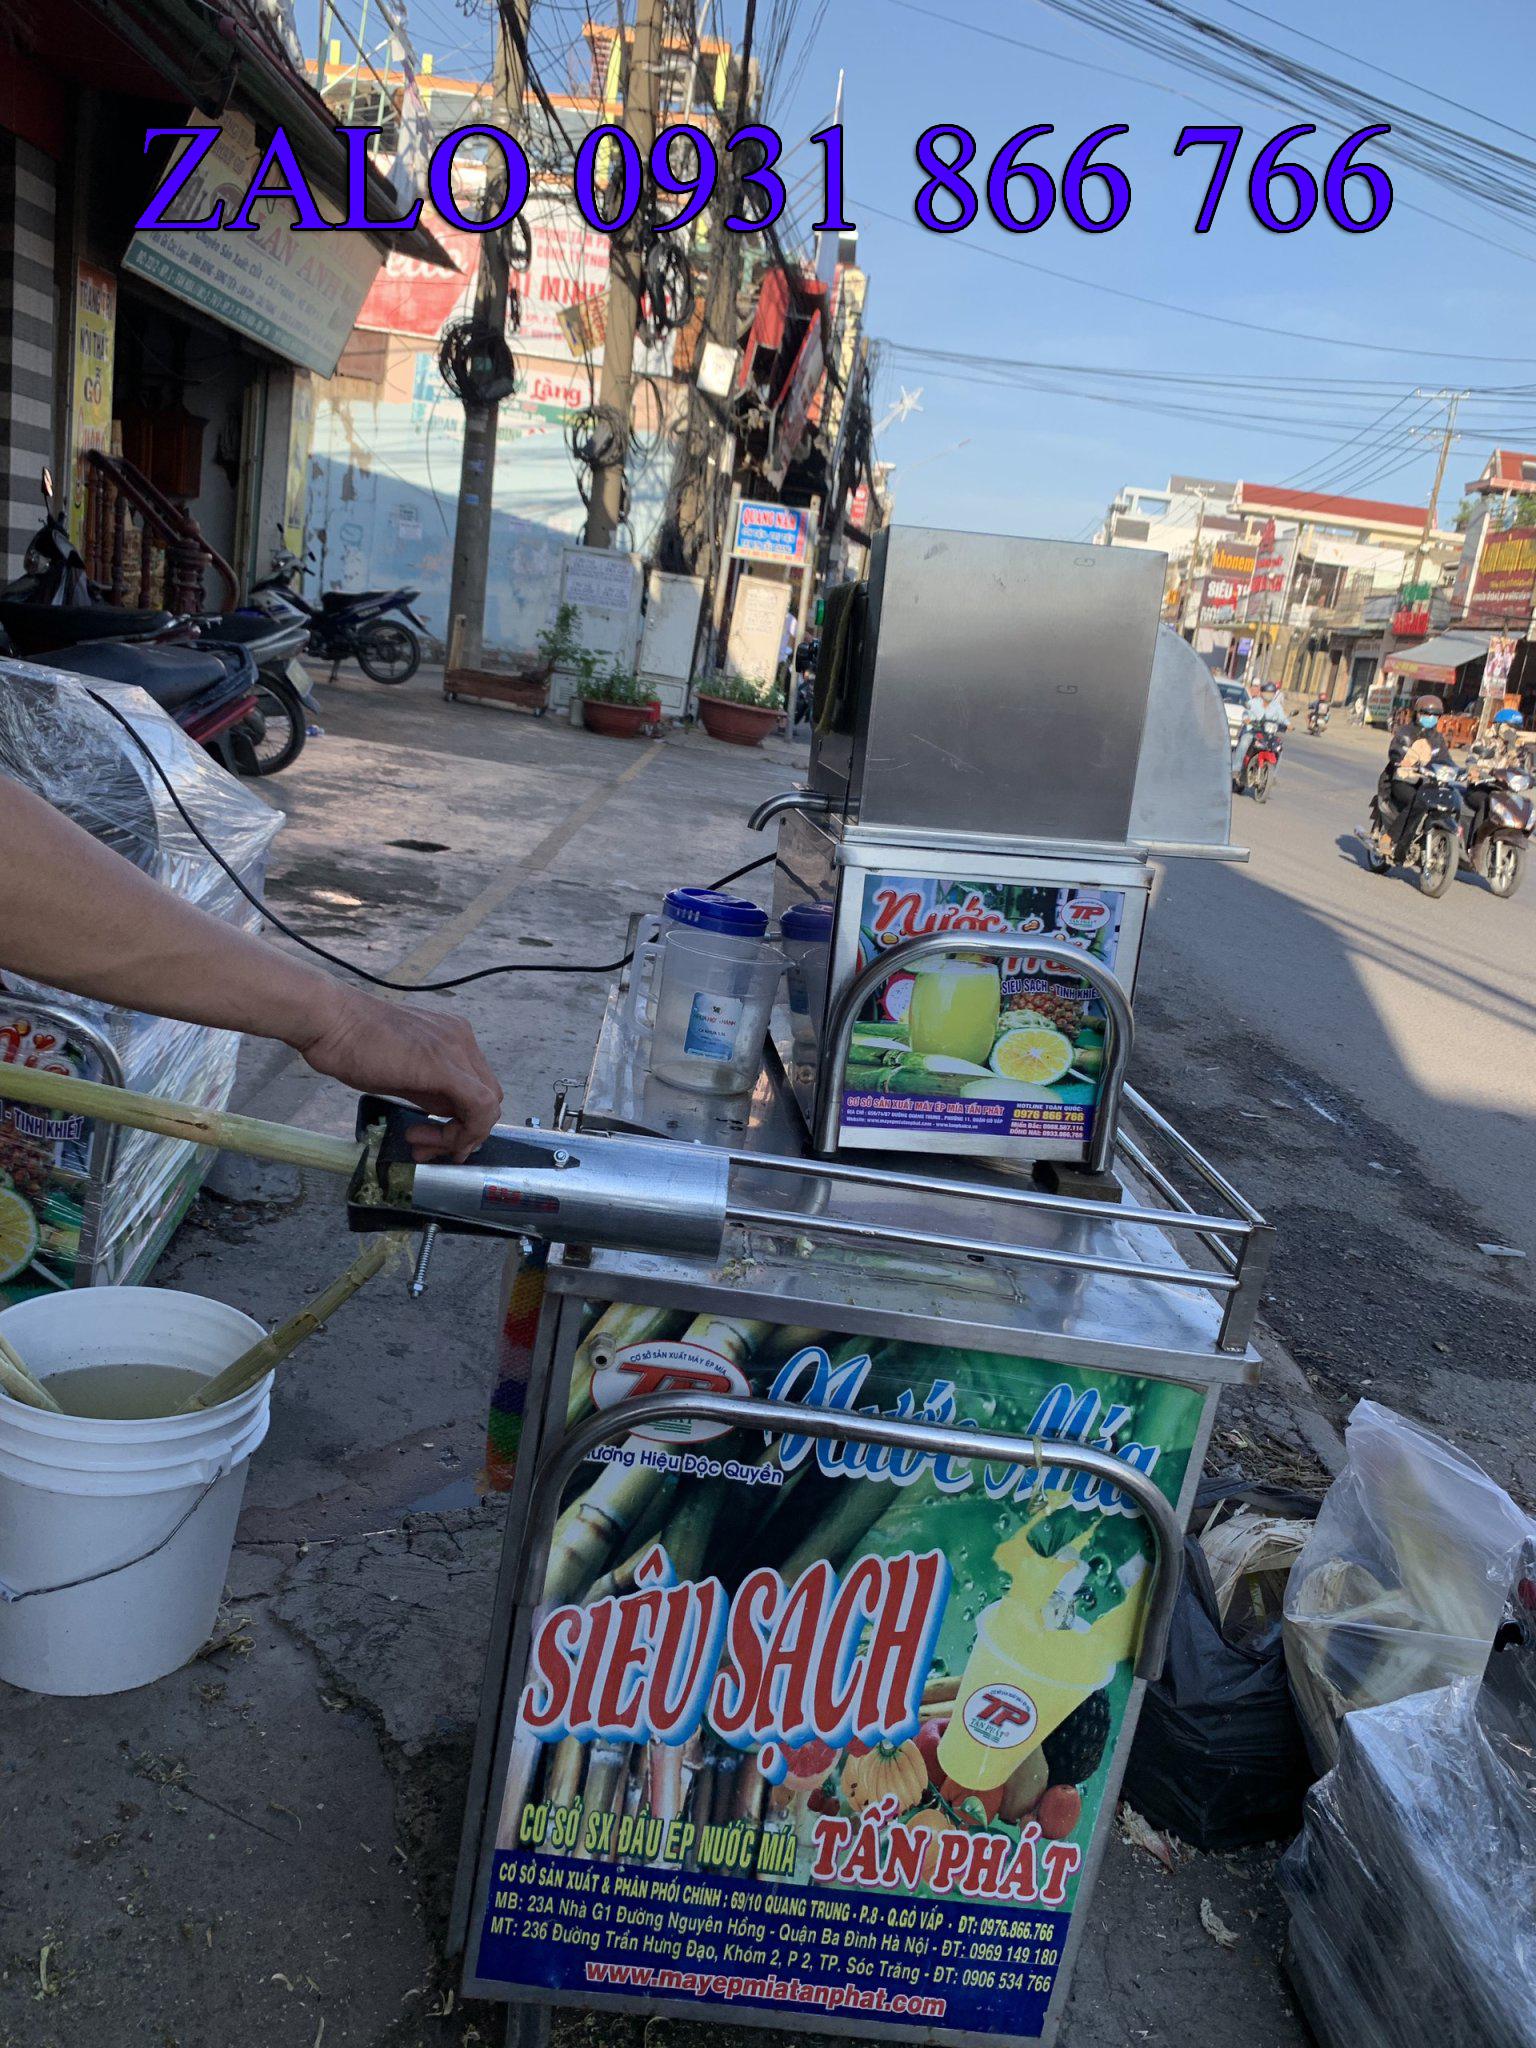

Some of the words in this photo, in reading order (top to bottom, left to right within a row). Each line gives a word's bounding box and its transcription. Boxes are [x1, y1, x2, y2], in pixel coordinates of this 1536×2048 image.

[84, 367, 103, 406] GỖ
[1207, 580, 1234, 600] SIÊU
[1069, 905, 1105, 920] TP
[1001, 979, 1023, 995] SIÊU
[1023, 979, 1049, 996] SẠCH
[1055, 983, 1077, 999] TINH
[13, 1108, 43, 1137] TINH
[45, 1112, 85, 1140] KHIẾT
[873, 1096, 891, 1109] SẢN
[892, 1097, 914, 1111] XUẤT
[914, 1099, 933, 1112] MÁY
[934, 1100, 946, 1113] ÉP
[946, 1101, 964, 1114] MÍA
[964, 1102, 983, 1115] TẤN
[983, 1104, 1005, 1117] PHÁT
[1013, 1108, 1041, 1119] 0976
[630, 1354, 642, 1363] CƠ
[642, 1350, 652, 1360] SỞ
[652, 1348, 667, 1359] SẢN
[668, 1350, 687, 1361] XUẤT
[688, 1353, 705, 1365] MÁY
[705, 1357, 715, 1368] ÉP
[715, 1363, 728, 1376] MÍA
[587, 1445, 635, 1468] ương
[640, 1450, 680, 1473] Hiệu
[684, 1455, 720, 1478] Độc
[723, 1460, 784, 1486] Quyền
[522, 1544, 726, 1745] SIÊU
[709, 1548, 950, 1778] SẠCH
[976, 1692, 1031, 1727] TP
[519, 1801, 550, 1845] CƠ
[551, 1795, 584, 1850] SỞ
[584, 1810, 617, 1853] SX
[617, 1802, 664, 1862] ĐẦU
[664, 1812, 696, 1862] ÉP
[697, 1820, 756, 1869] NƯỚC
[757, 1823, 798, 1877] MÍA
[811, 1793, 931, 1889] TẤN
[930, 1822, 1082, 1906] PHÁT
[499, 1861, 517, 1882] CƠ
[519, 1858, 537, 1884] SỞ
[538, 1861, 564, 1888] SẢN
[566, 1865, 600, 1892] XUẤT
[601, 1875, 611, 1895] &
[613, 1874, 649, 1899] PHÂN
[650, 1876, 681, 1903] PHỐI
[682, 1881, 722, 1908] CHÍNH
[730, 1890, 762, 1912] 69/10
[764, 1894, 808, 1918] QUANG
[810, 1899, 851, 1922] TRUNG
[859, 1904, 878, 1925] P.8
[887, 1904, 917, 1930] Q.GÒ
[919, 1904, 945, 1931] VẤP
[957, 1915, 978, 1935] ĐT:
[979, 1917, 1056, 1942] 0976.866.766
[494, 1891, 523, 1911] MB:
[527, 1895, 555, 1914] 23A
[558, 1897, 587, 1919] Nhà
[592, 1902, 612, 1921] G1
[616, 1904, 665, 1932] Đường
[667, 1911, 723, 1936] Nguyên
[727, 1915, 766, 1942] Hồng
[779, 1922, 817, 1947] Quận
[821, 1927, 841, 1946] Ba
[843, 1929, 877, 1949] Đình
[881, 1933, 901, 1952] Hà
[904, 1935, 930, 1957] Nội
[941, 1939, 966, 1959] ĐT:
[968, 1942, 1003, 1961] 0969
[1006, 1945, 1031, 1964] 149
[1034, 1948, 1059, 1966] 180
[490, 1915, 518, 1936] MT:
[521, 1919, 549, 1940] 236
[551, 1922, 601, 1951] Đường
[605, 1929, 639, 1951] Trần
[642, 1934, 683, 1960] Hưng
[685, 1939, 719, 1964] Đạo,
[723, 1943, 767, 1965] Khóm
[769, 1948, 782, 1969] 2,
[787, 1950, 799, 1967] P
[801, 1952, 814, 1972] 2,
[819, 1953, 841, 1973] TP.
[846, 1956, 875, 1977] Sóc
[879, 1960, 921, 1985] Trăng
[933, 1965, 959, 1985] ĐT:
[962, 1968, 996, 1990] 0906
[998, 1972, 1025, 1991] 534
[1026, 1974, 1052, 1993] 766
[585, 1961, 947, 2018] www.mayepmiatanphat.com
